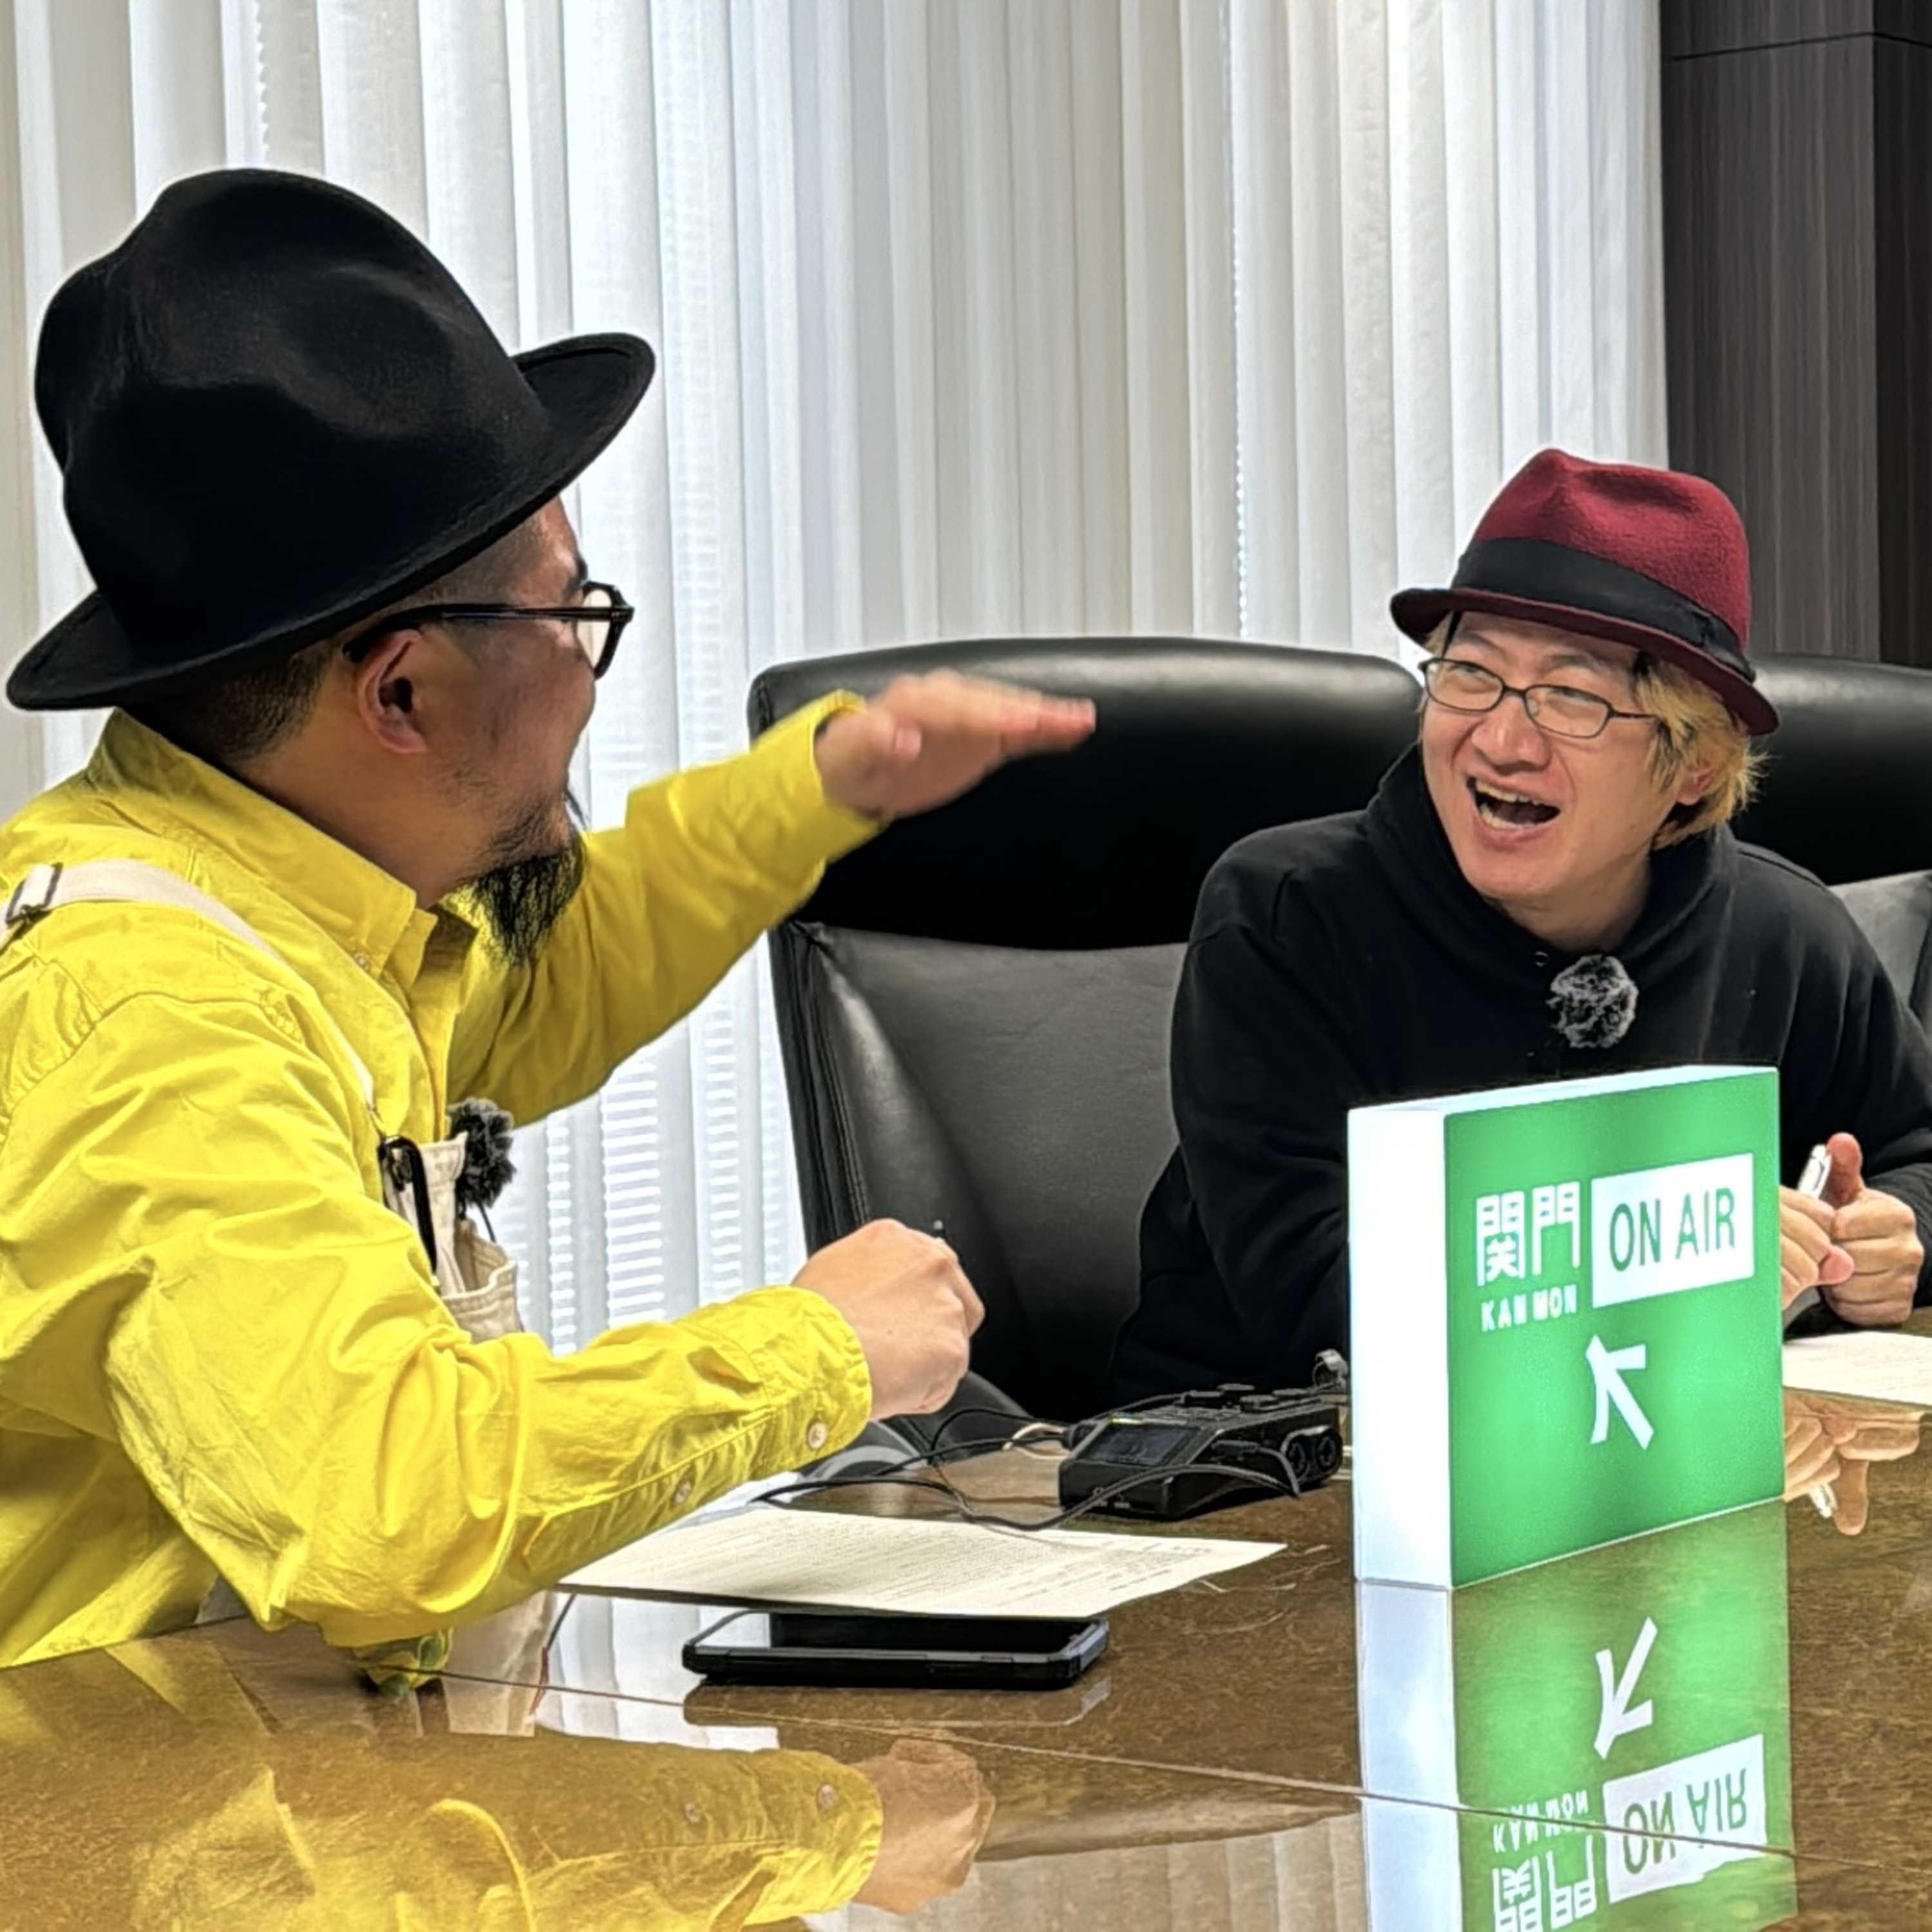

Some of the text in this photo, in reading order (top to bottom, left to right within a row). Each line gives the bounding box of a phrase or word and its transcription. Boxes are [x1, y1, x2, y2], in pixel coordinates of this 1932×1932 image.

[1476, 1181, 1580, 1287] 関門
[1610, 1188, 1735, 1272] ON AIR
